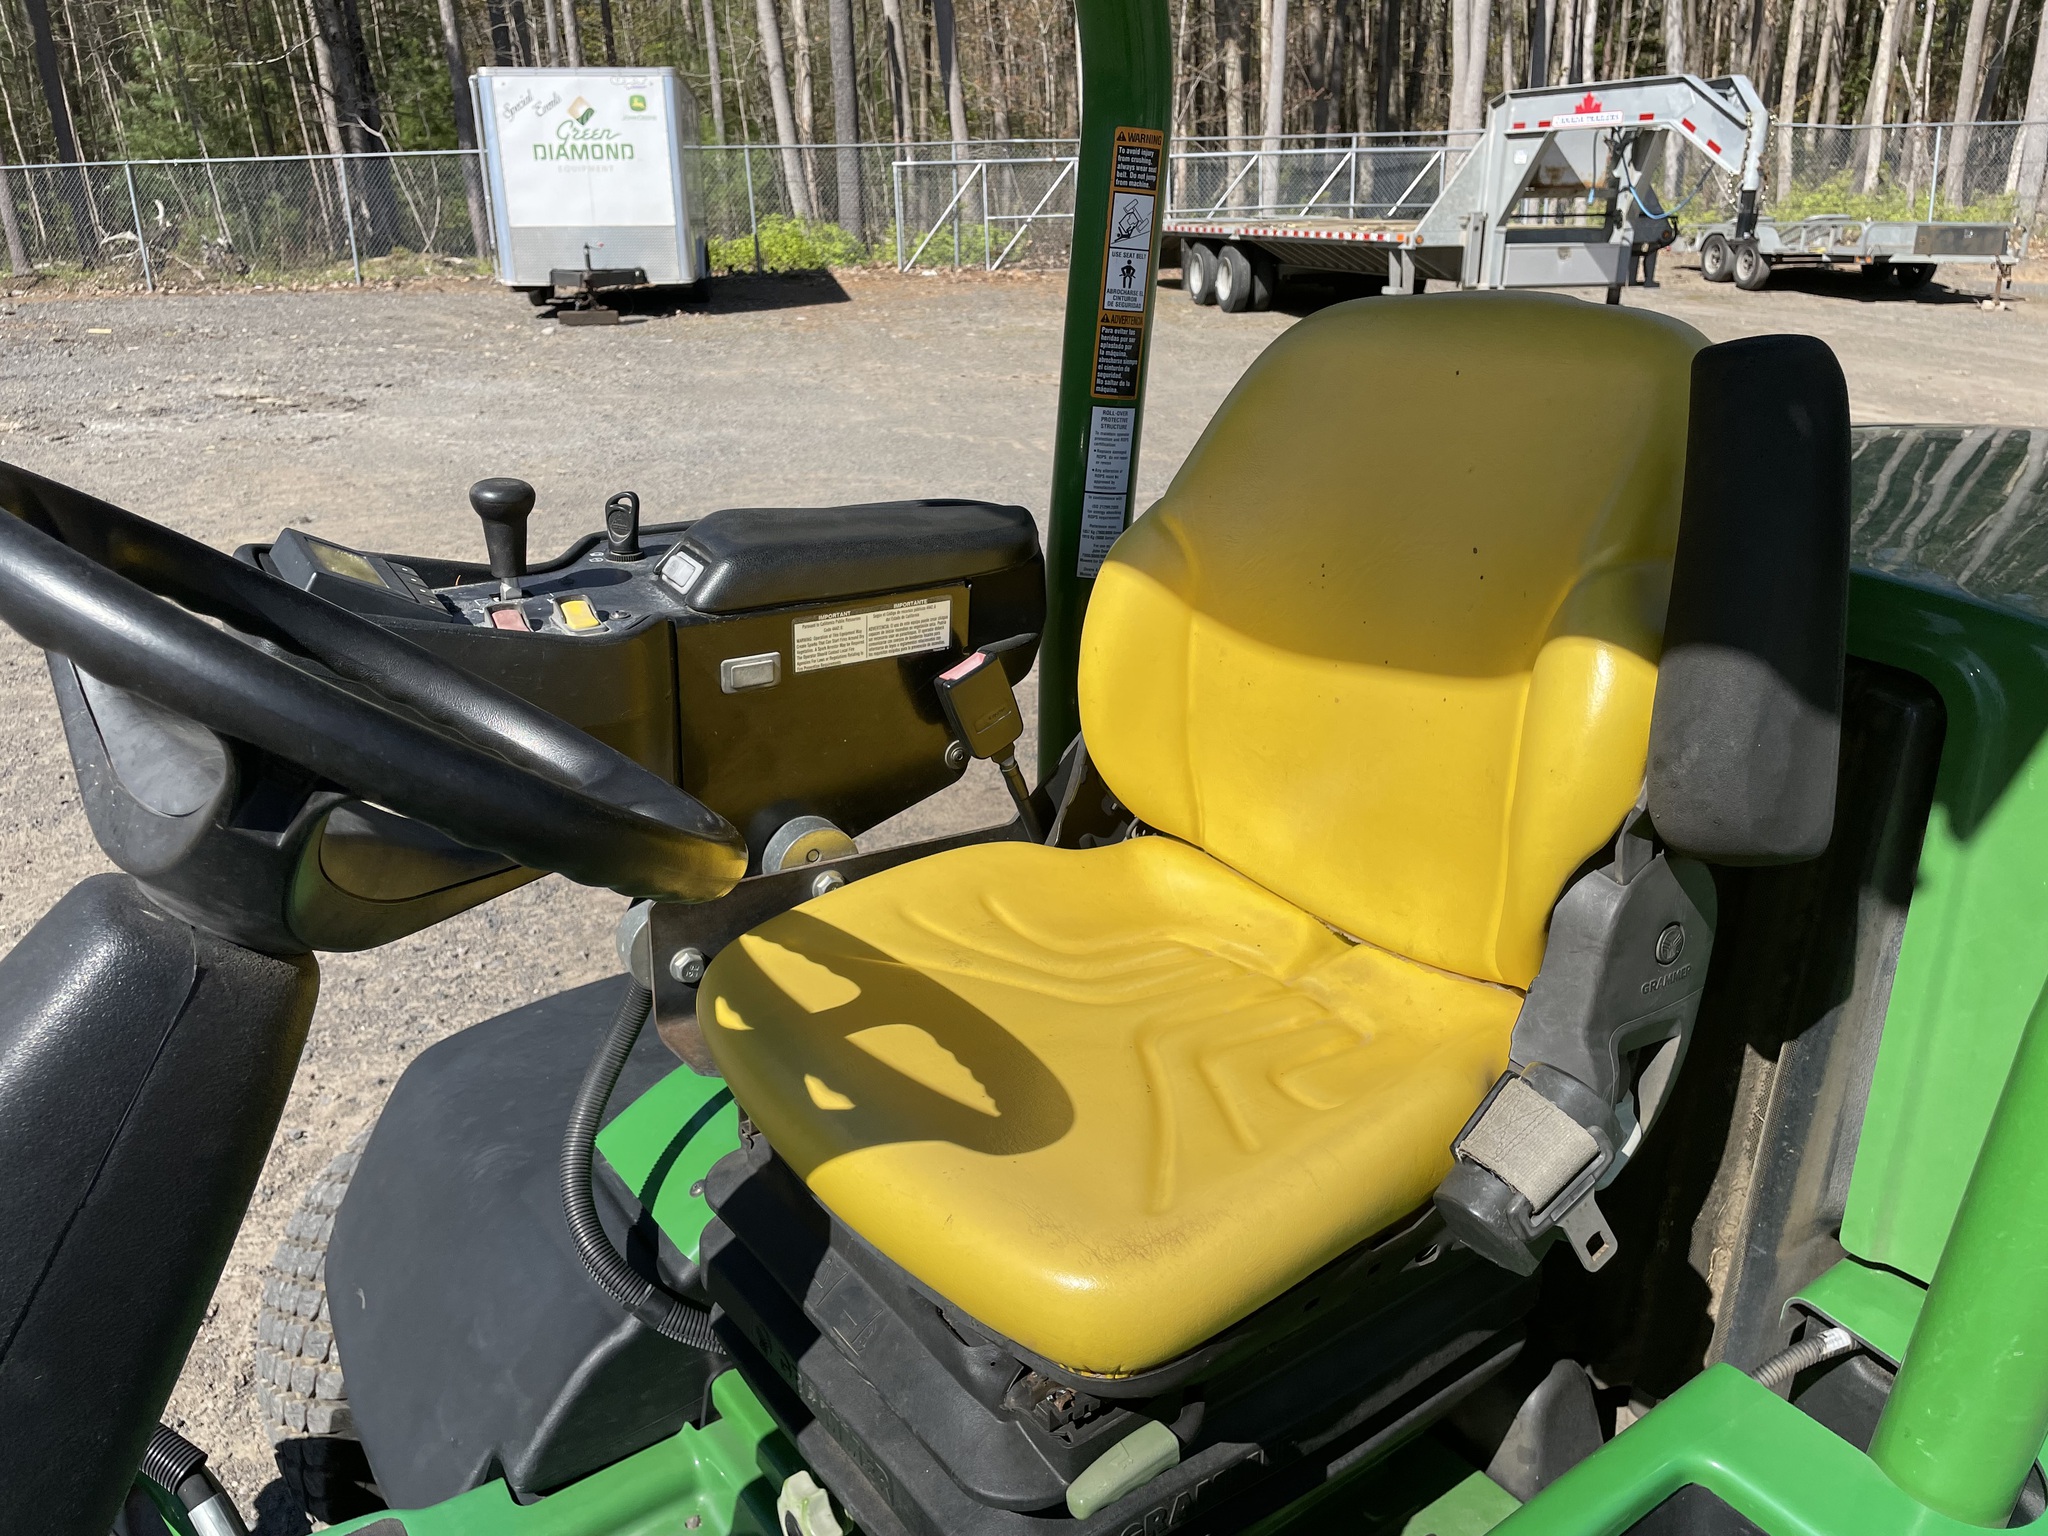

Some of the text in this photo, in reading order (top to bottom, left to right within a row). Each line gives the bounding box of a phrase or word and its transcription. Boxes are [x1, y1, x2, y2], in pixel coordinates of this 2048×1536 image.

[502, 88, 562, 122] Special Events
[556, 119, 622, 144] Green
[1128, 132, 1162, 145] WARNING
[533, 143, 634, 160] DIAMOND
[1126, 147, 1140, 155] avoid
[1141, 149, 1154, 157] injury
[558, 165, 614, 173] EQUIPMENT
[1117, 163, 1135, 172] always
[1116, 178, 1128, 186] from
[894, 600, 928, 608] IMPORTANTE
[818, 611, 851, 620] IMPORTANT
